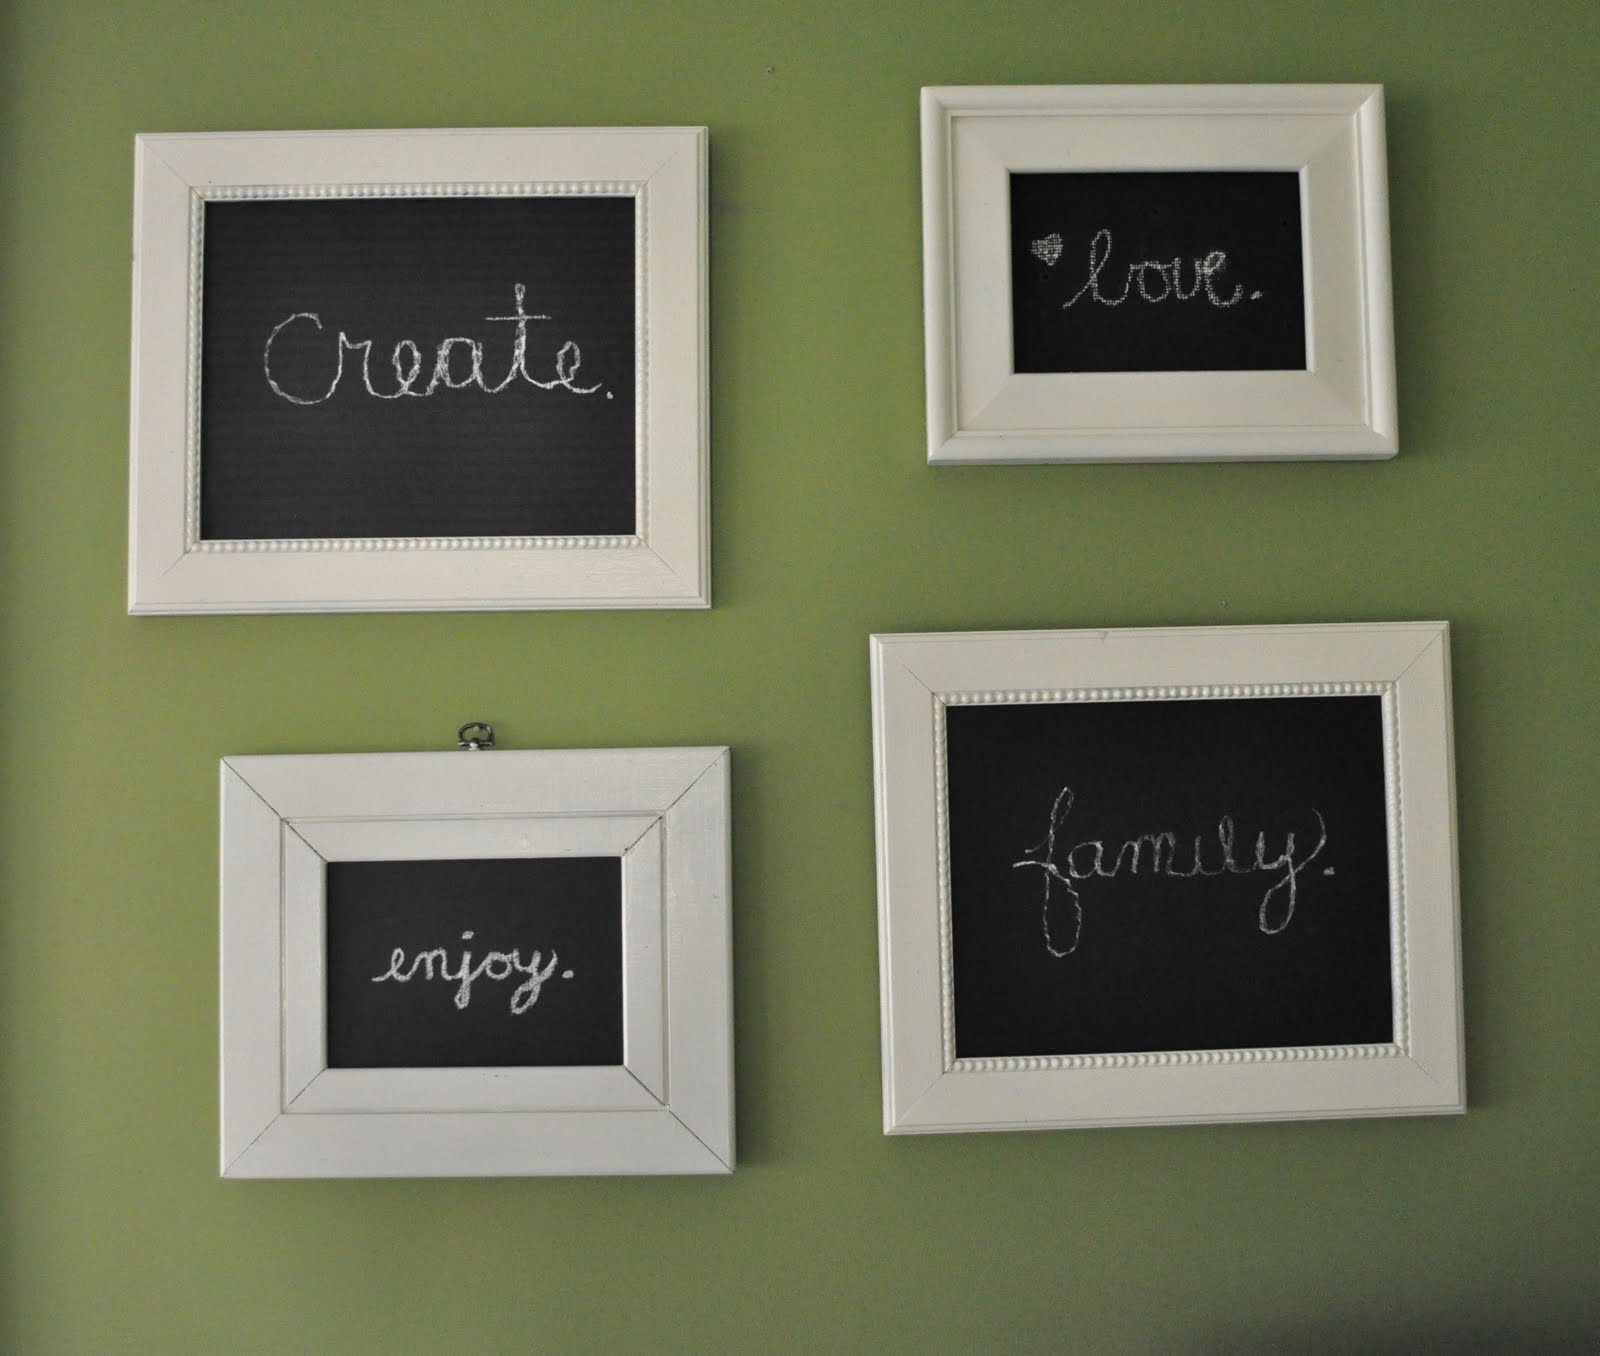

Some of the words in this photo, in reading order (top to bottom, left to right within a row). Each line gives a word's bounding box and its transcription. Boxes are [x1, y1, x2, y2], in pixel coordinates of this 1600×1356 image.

[1061, 228, 1264, 309] love.
[1012, 786, 1335, 958] family.
[371, 930, 575, 1015] enjoy.
